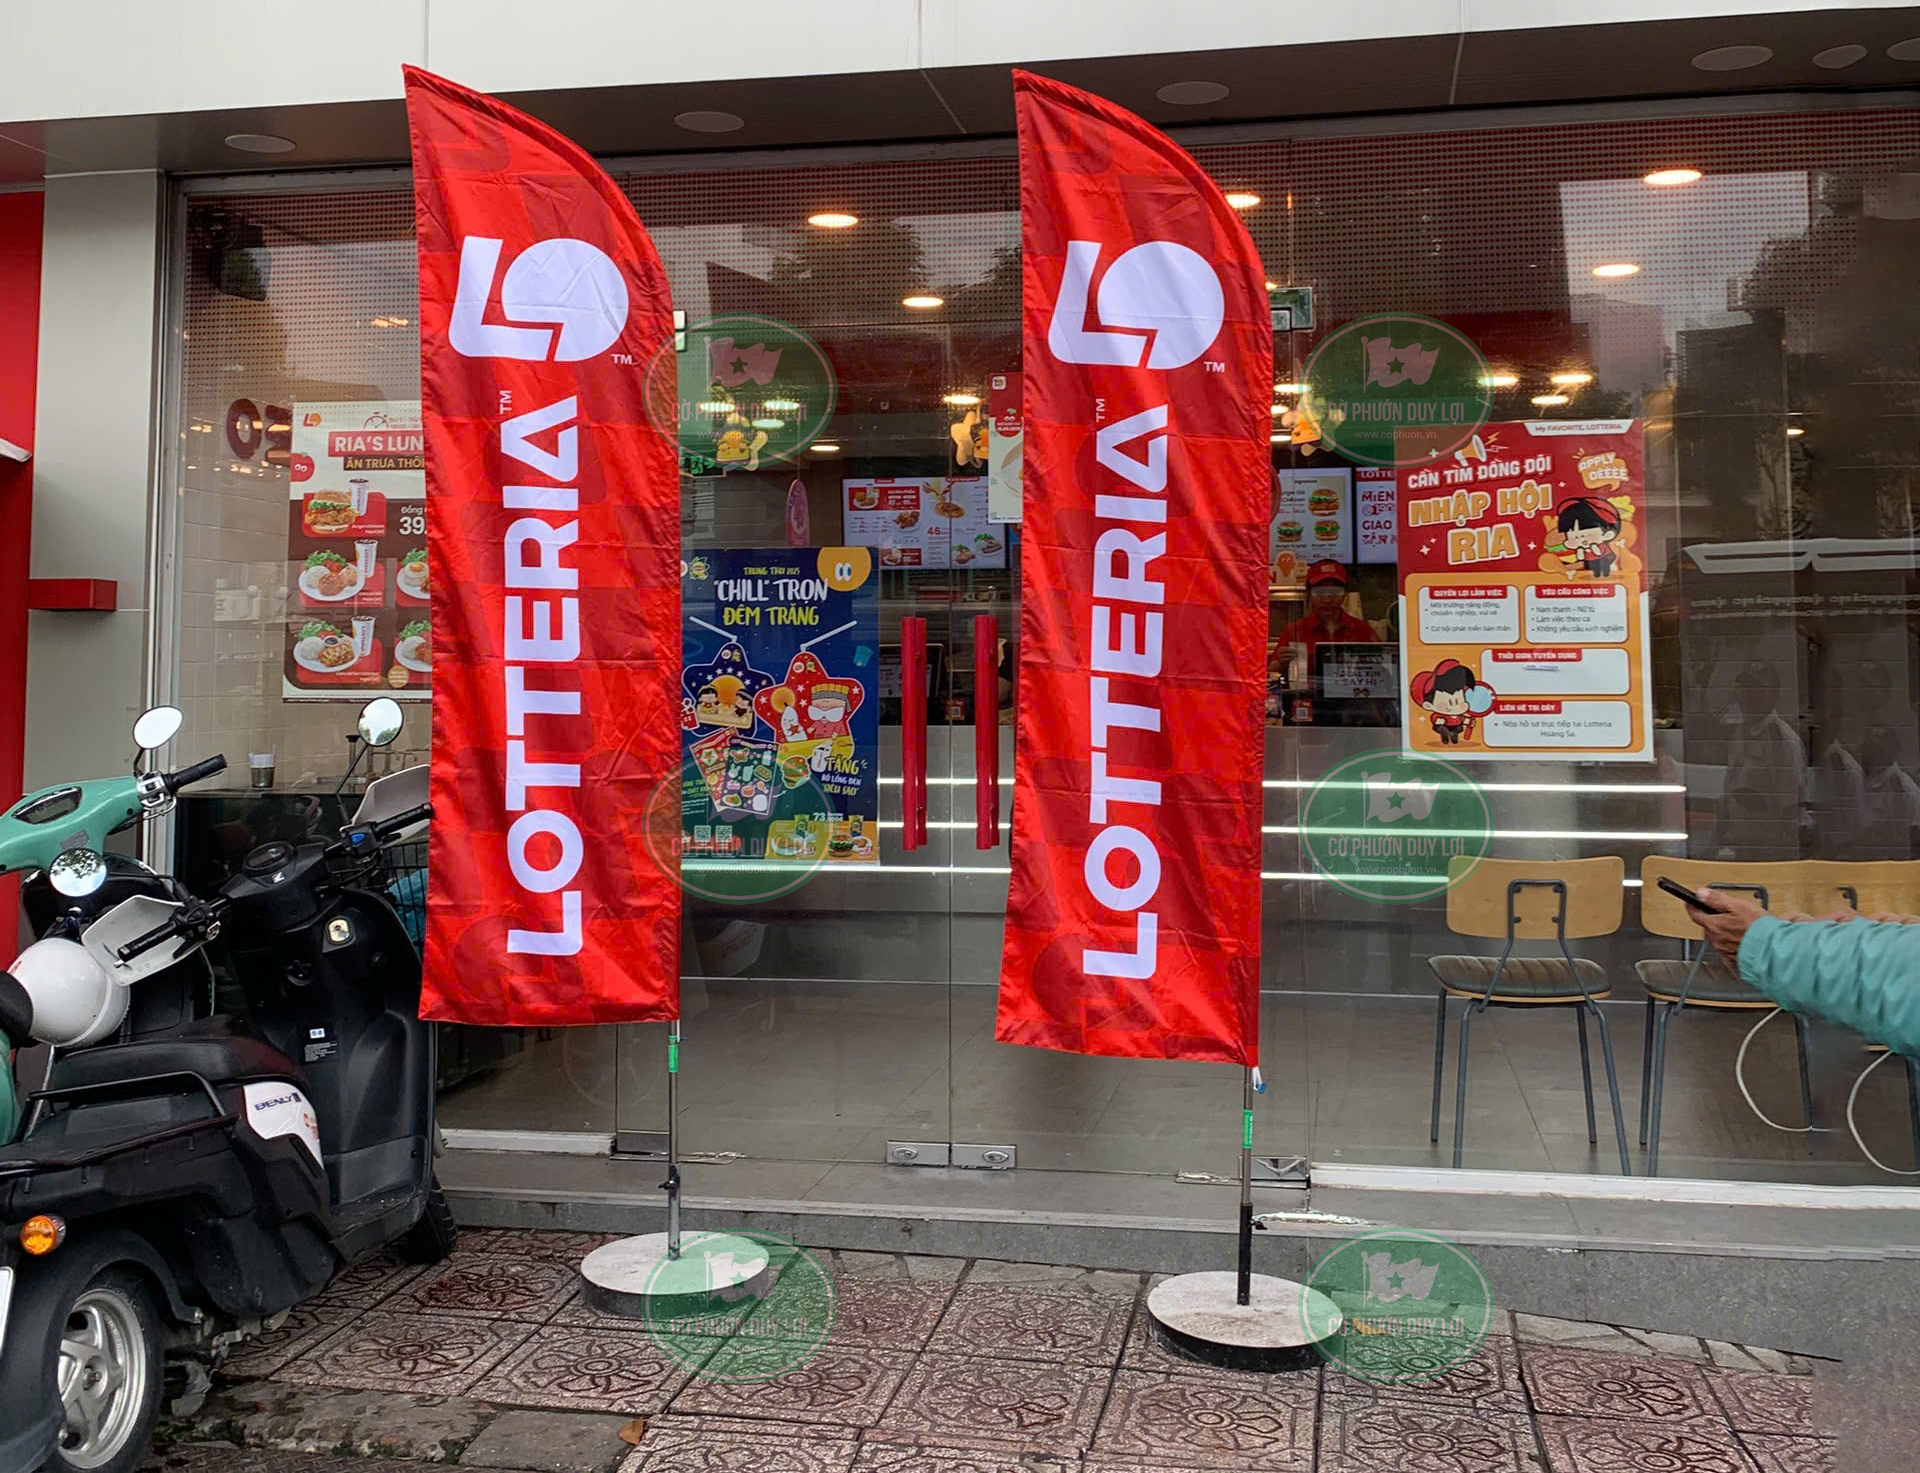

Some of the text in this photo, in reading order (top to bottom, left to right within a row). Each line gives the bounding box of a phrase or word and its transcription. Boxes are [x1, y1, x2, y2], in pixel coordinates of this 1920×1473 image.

[1587, 423, 1622, 431] LOTTERIA
[335, 436, 383, 452] RIA'S
[1408, 454, 1552, 489] CẦN TÌM ĐỒNG ĐỘI
[1578, 452, 1616, 473] APPLY
[1409, 479, 1553, 527] NHẬP HỘI
[1362, 520, 1392, 531] GIAO
[1448, 523, 1519, 565] RIA
[773, 578, 828, 604] TRỌN
[723, 603, 819, 626] ĐÊM TRĂNG
[501, 395, 583, 956] LOTTERIA
[1083, 404, 1168, 980] LOTTERIA
